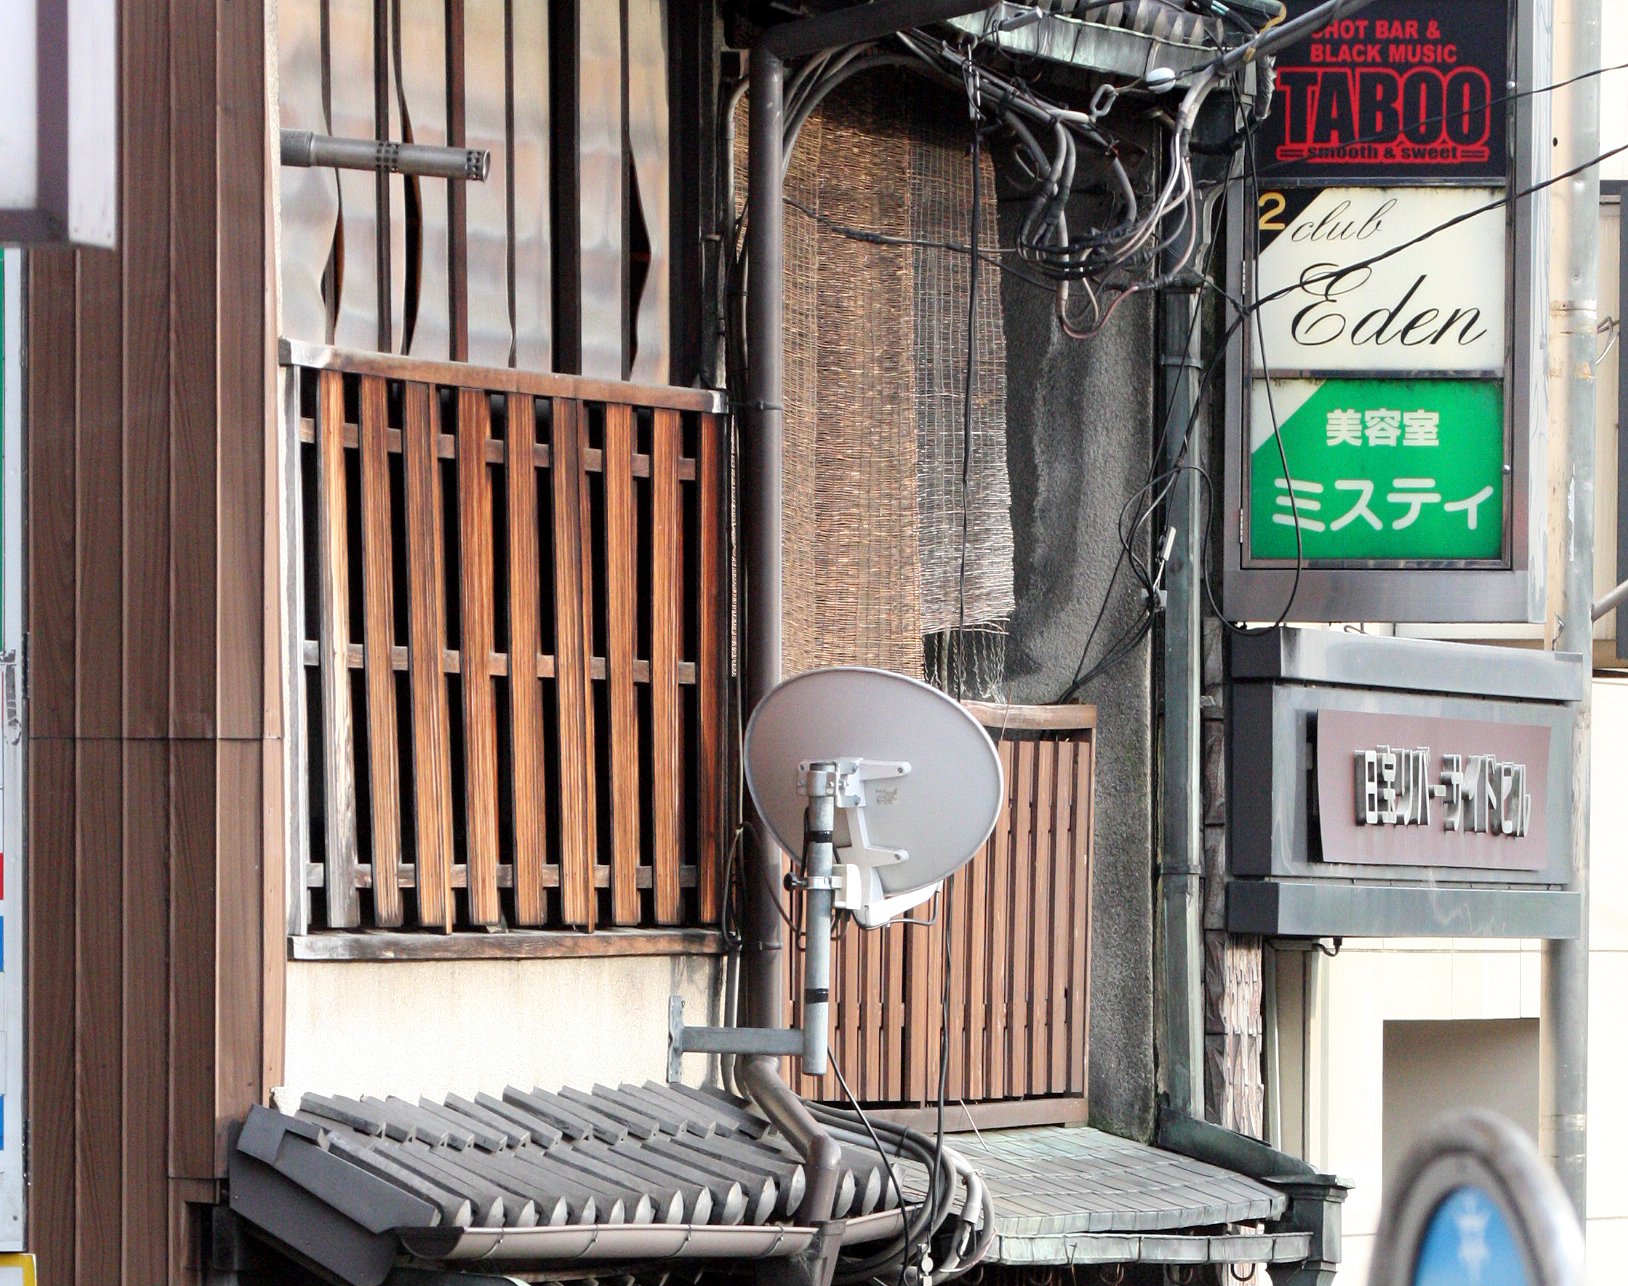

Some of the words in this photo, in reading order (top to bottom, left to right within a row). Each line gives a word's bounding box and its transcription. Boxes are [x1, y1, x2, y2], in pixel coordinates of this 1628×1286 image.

[1375, 18, 1419, 39] BAR
[1426, 19, 1442, 39] &
[1310, 44, 1382, 63] BLACK
[1388, 44, 1457, 63] MUSIC
[1276, 66, 1491, 146] TABOO
[1308, 144, 1379, 160] smooth
[1383, 145, 1395, 160] &
[1400, 145, 1459, 160] sweet
[1291, 198, 1398, 242] club
[1291, 262, 1487, 346] Eden
[1325, 408, 1440, 447] 美容室
[1272, 477, 1494, 532] ミスティ
